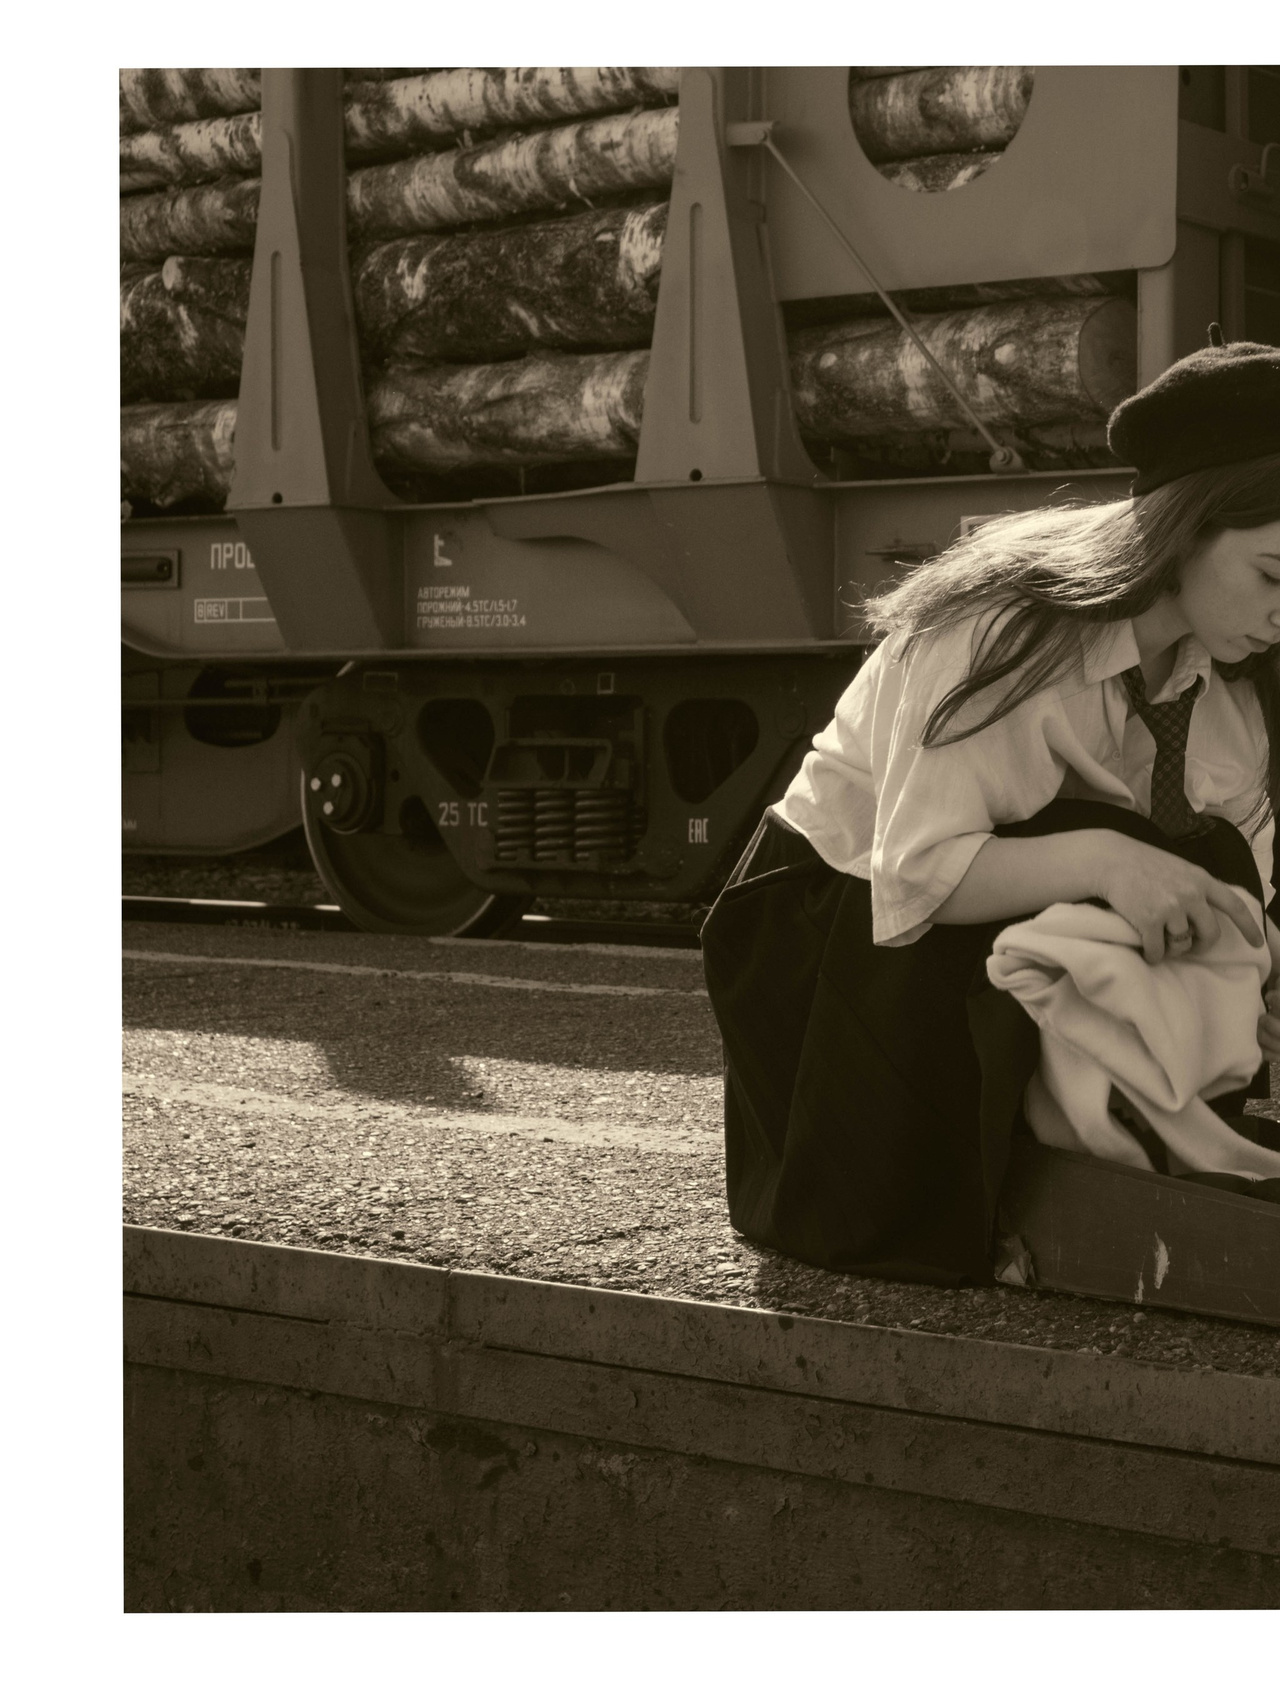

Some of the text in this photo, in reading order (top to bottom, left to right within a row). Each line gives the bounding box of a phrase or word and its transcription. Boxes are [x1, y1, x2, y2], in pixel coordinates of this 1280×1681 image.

[417, 585, 470, 600] АВТОРЕЖИМ
[206, 603, 225, 618] REV
[438, 801, 488, 827] 25 ТС
